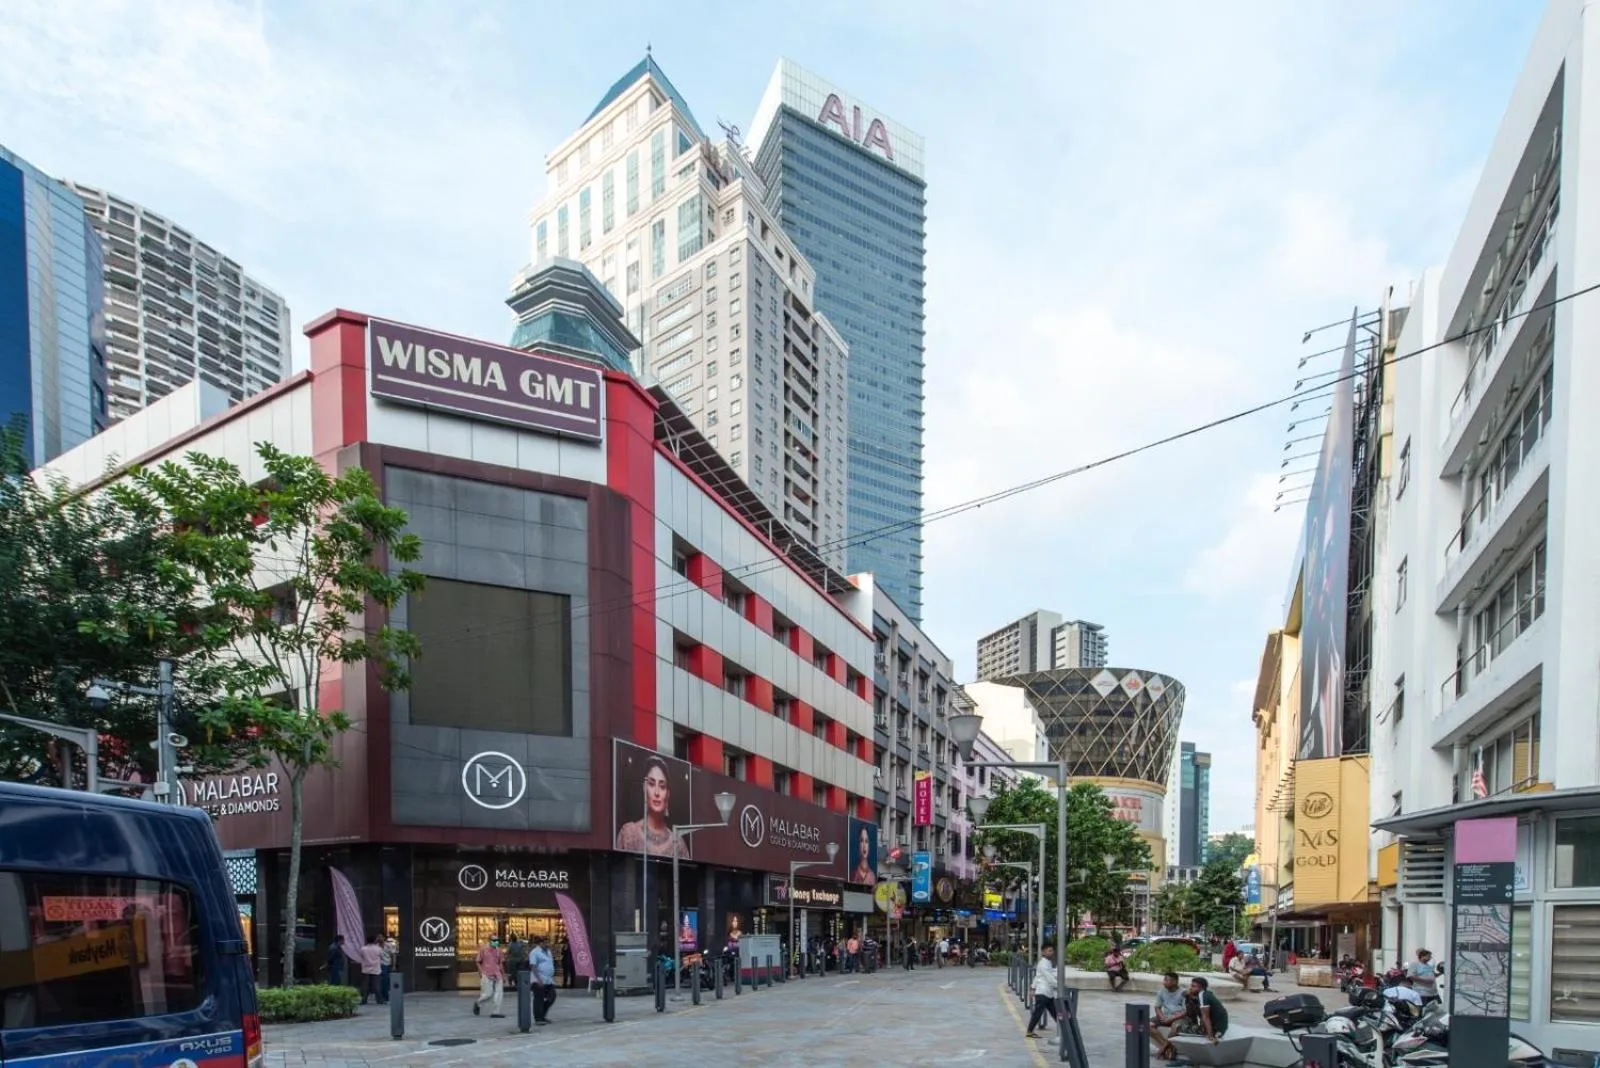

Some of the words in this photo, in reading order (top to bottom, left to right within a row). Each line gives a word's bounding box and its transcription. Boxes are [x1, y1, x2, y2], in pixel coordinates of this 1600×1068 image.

[818, 93, 894, 161] AIA
[376, 336, 507, 392] WISMA
[519, 369, 596, 409] GMT
[193, 772, 278, 802] MALABAR
[220, 804, 228, 815] &
[227, 798, 279, 814] DIAMONDS
[919, 781, 930, 824] HOTEL
[769, 816, 821, 841] MALABAR
[1298, 828, 1338, 850] MS
[1296, 854, 1337, 867] GOLD
[495, 869, 569, 881] MALABAR
[812, 889, 840, 905] Exchange
